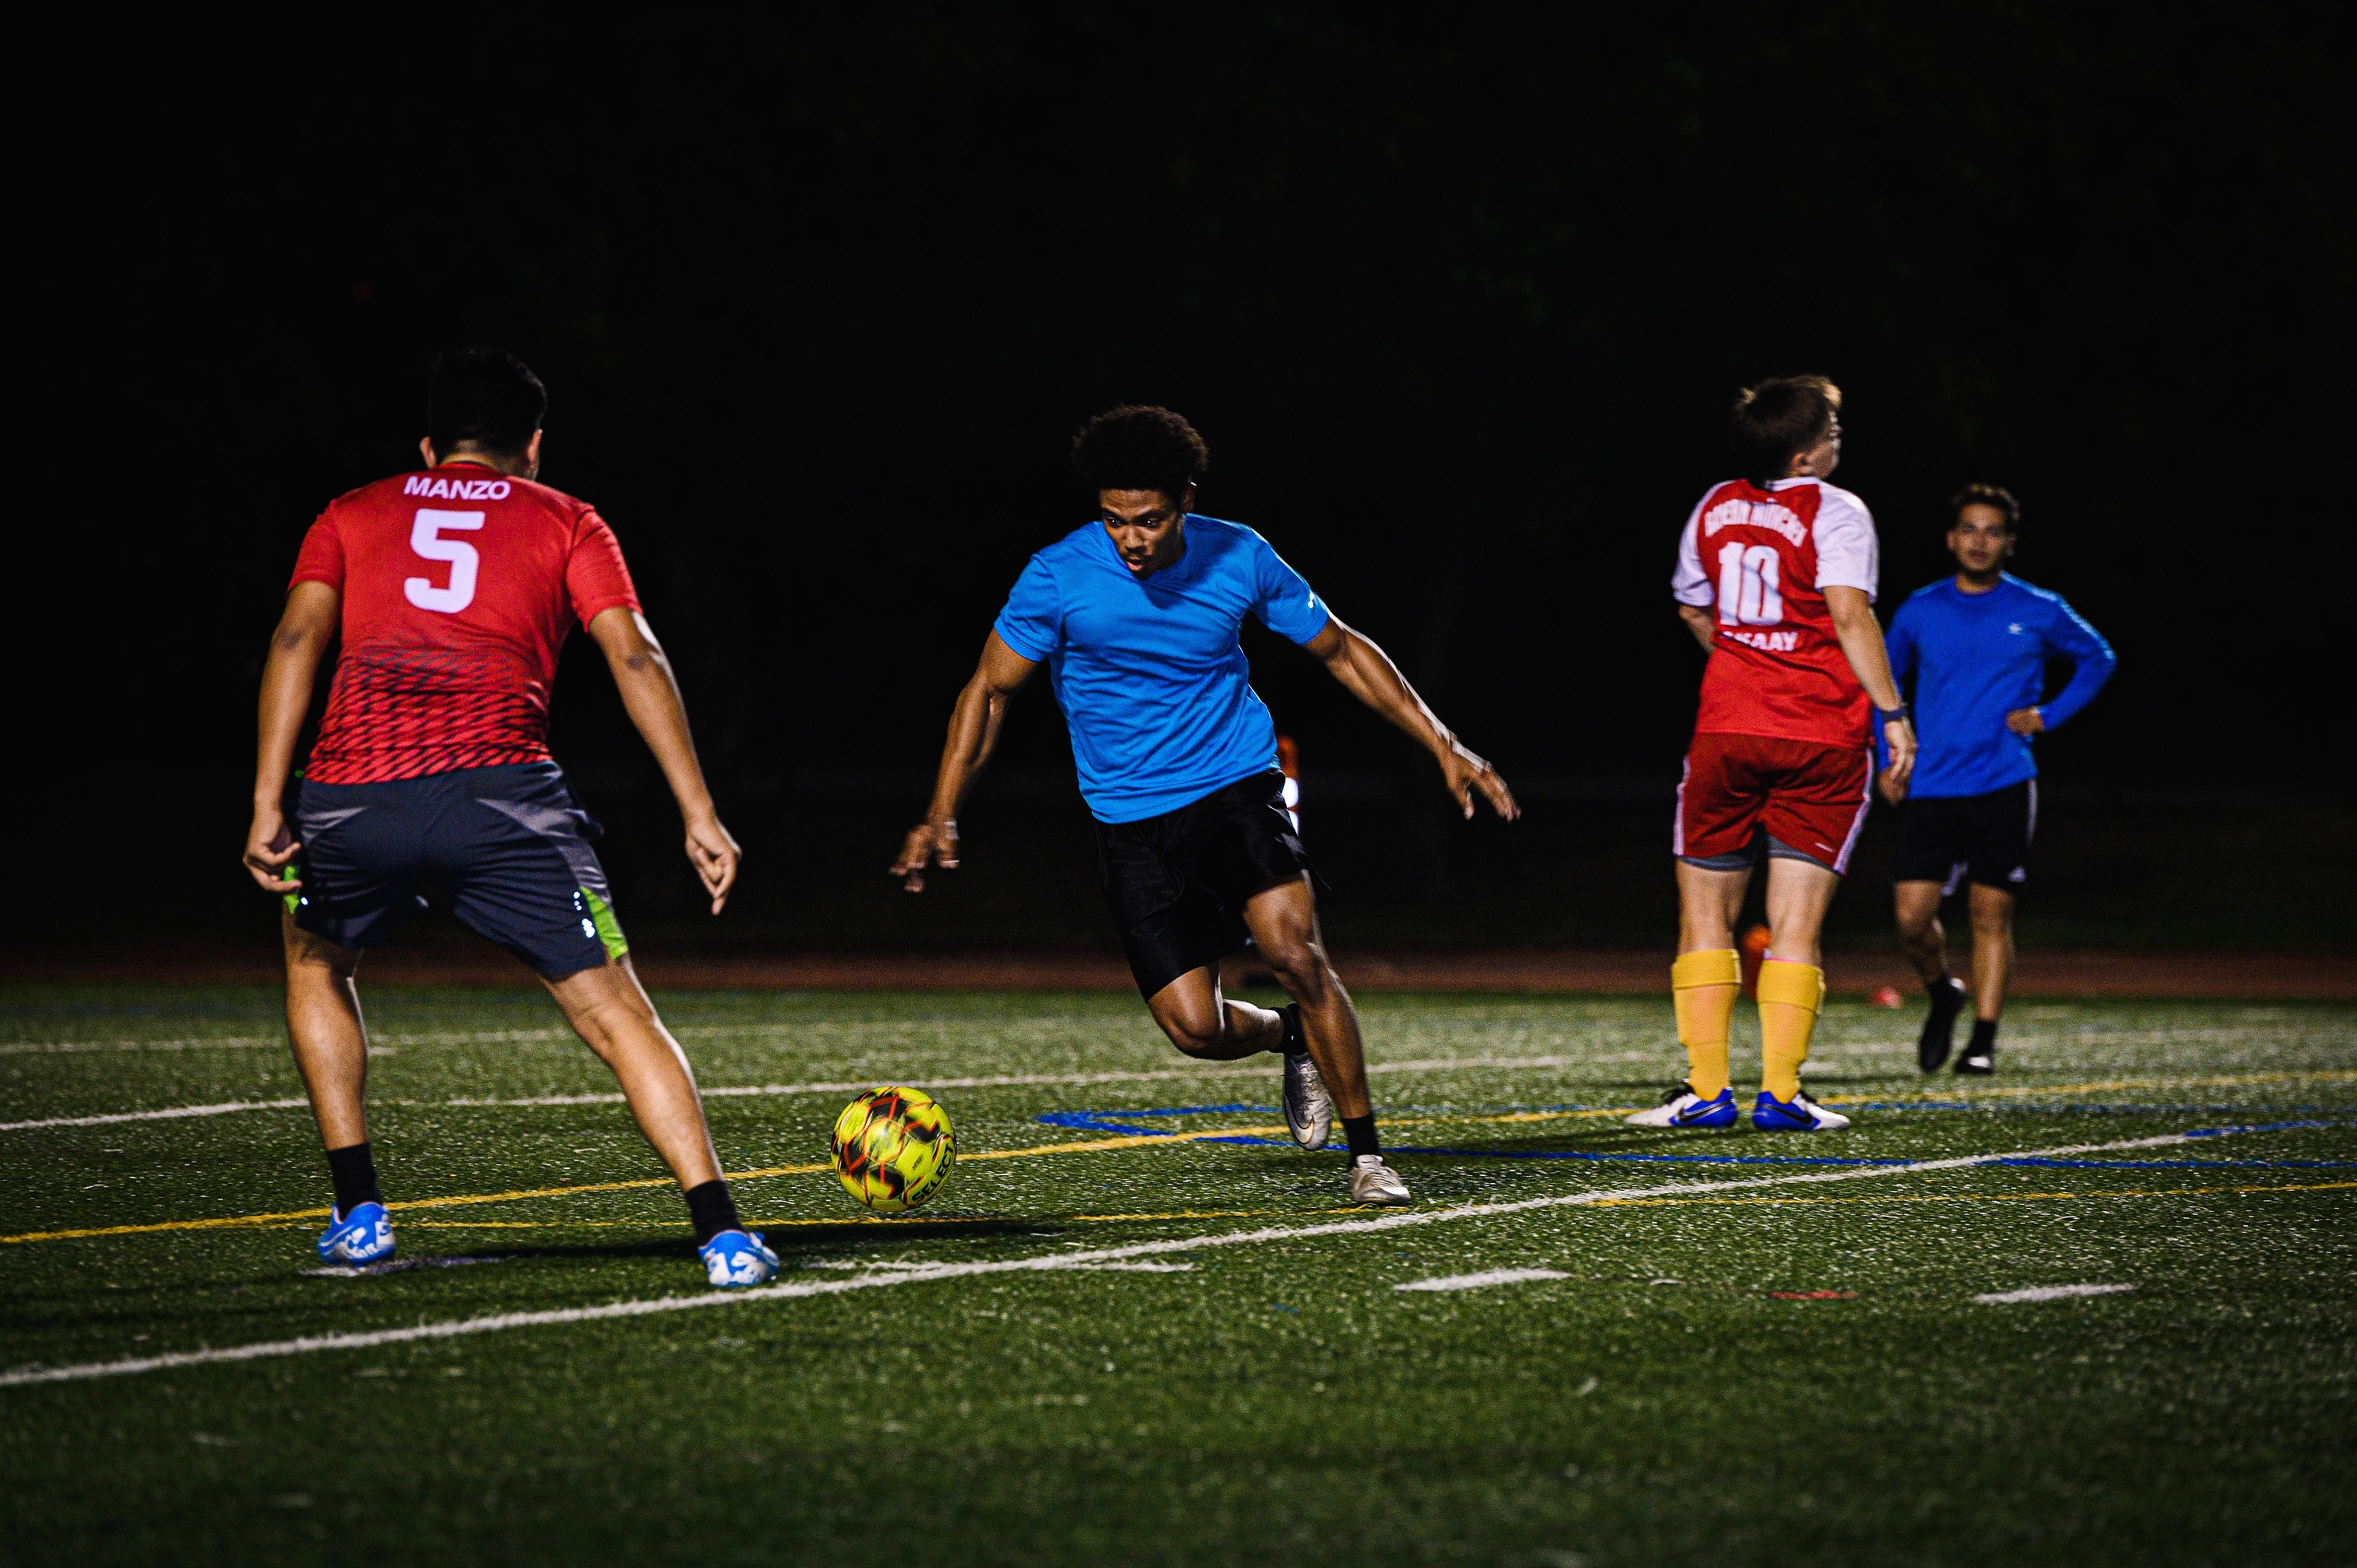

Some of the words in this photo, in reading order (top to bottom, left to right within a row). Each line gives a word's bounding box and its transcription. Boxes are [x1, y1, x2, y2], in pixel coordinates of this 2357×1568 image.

[403, 475, 511, 500] MANZO
[404, 508, 486, 614] 5
[1718, 541, 1784, 627] 10
[911, 1142, 954, 1202] SELECT
